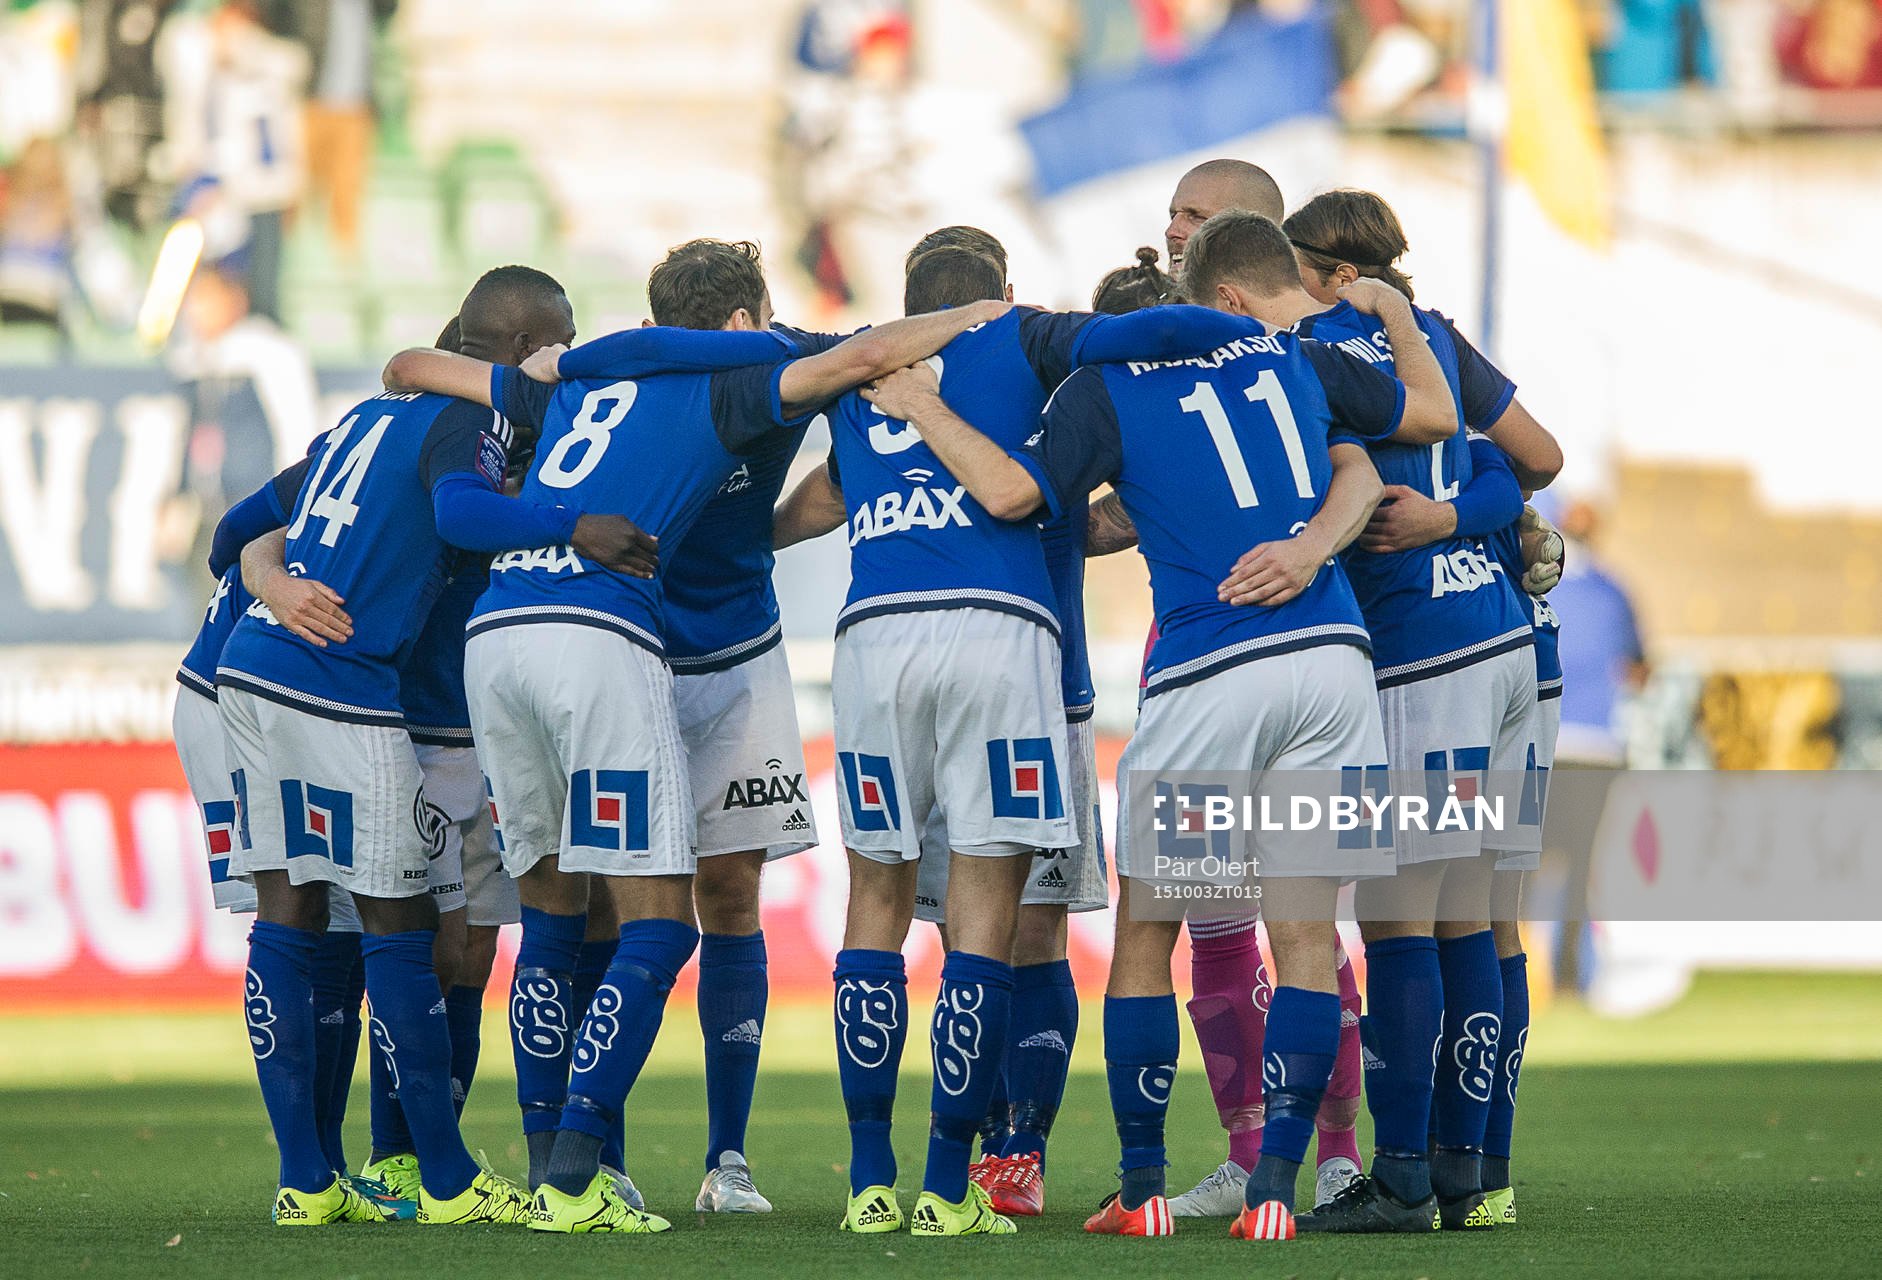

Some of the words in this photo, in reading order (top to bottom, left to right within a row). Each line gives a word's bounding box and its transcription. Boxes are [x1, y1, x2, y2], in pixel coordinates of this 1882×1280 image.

[538, 380, 638, 489] 8
[1179, 369, 1315, 508] 11
[286, 414, 394, 548] 14
[850, 485, 973, 548] ABAX
[722, 773, 808, 810] ABAX
[782, 821, 810, 832] adidas
[1037, 879, 1068, 888] adidas
[857, 1212, 897, 1227] adidas
